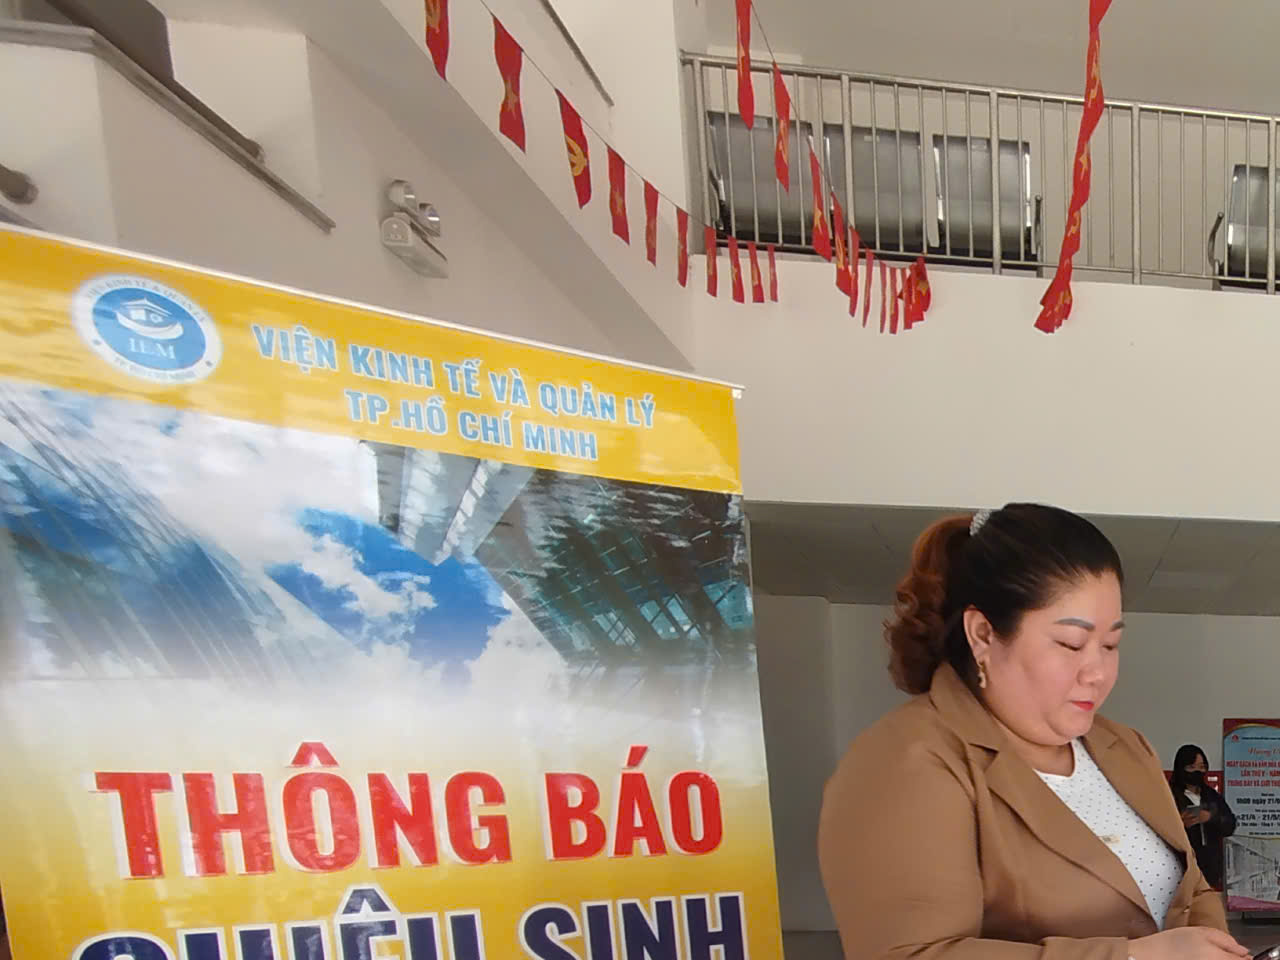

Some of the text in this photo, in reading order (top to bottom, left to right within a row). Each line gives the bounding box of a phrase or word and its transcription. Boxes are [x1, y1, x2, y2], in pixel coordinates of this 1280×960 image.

[252, 323, 656, 428] VIỆN KINH TẾ VÀ QUẢN LÝ
[344, 388, 598, 461] TP.HỒ CHÍ MINH
[91, 742, 725, 880] THÔNG BÁO
